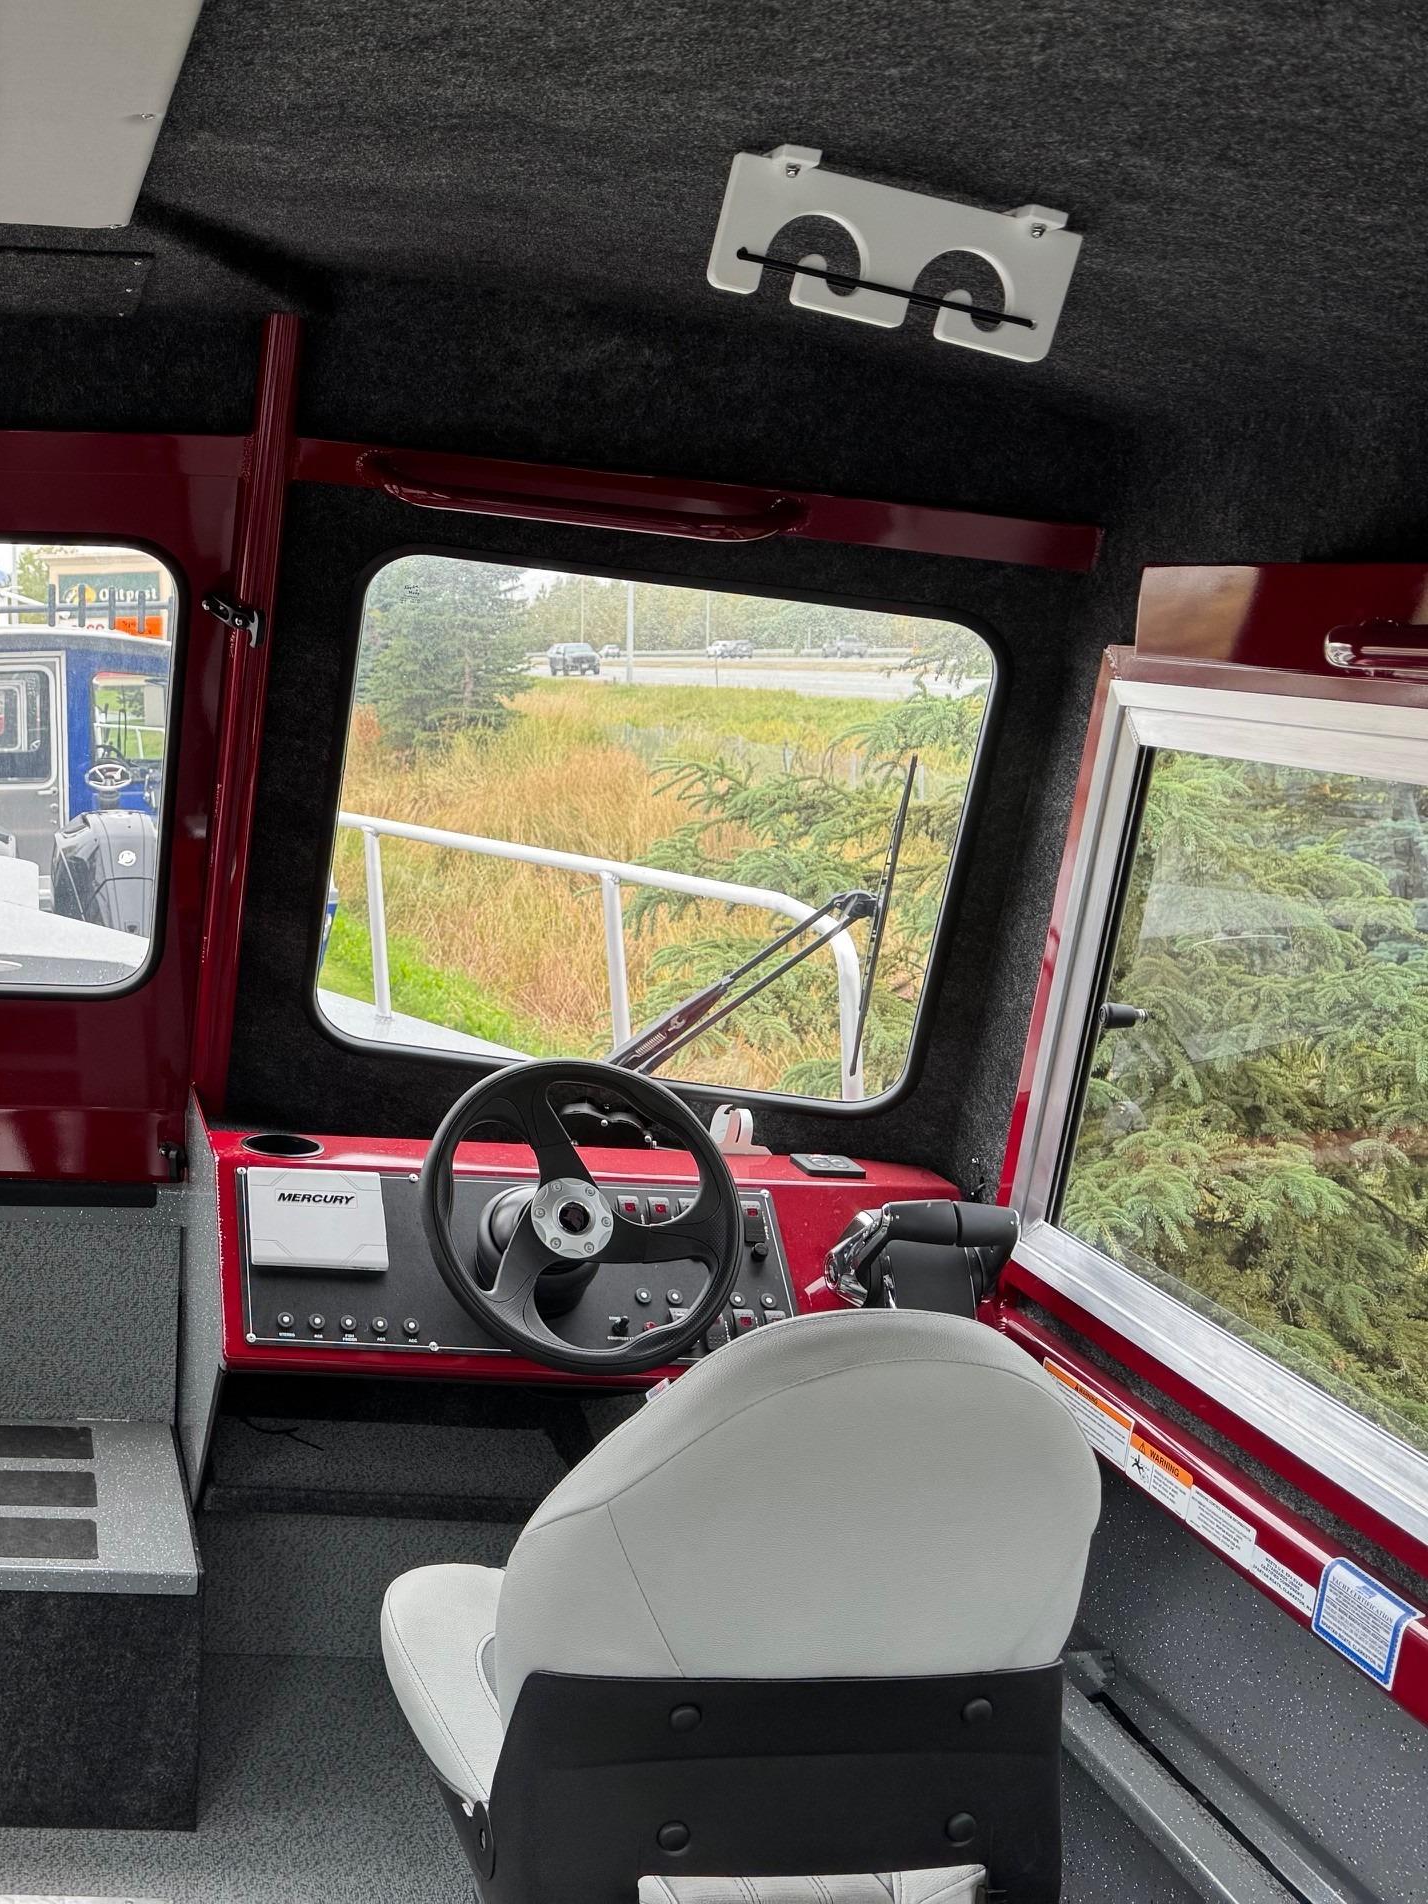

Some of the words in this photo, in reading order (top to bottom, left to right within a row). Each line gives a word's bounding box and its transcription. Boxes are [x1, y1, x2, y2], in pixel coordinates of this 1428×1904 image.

[99, 588, 157, 602] Otpst
[277, 1192, 355, 1205] MERCURY
[1149, 1449, 1180, 1477] WARNING
